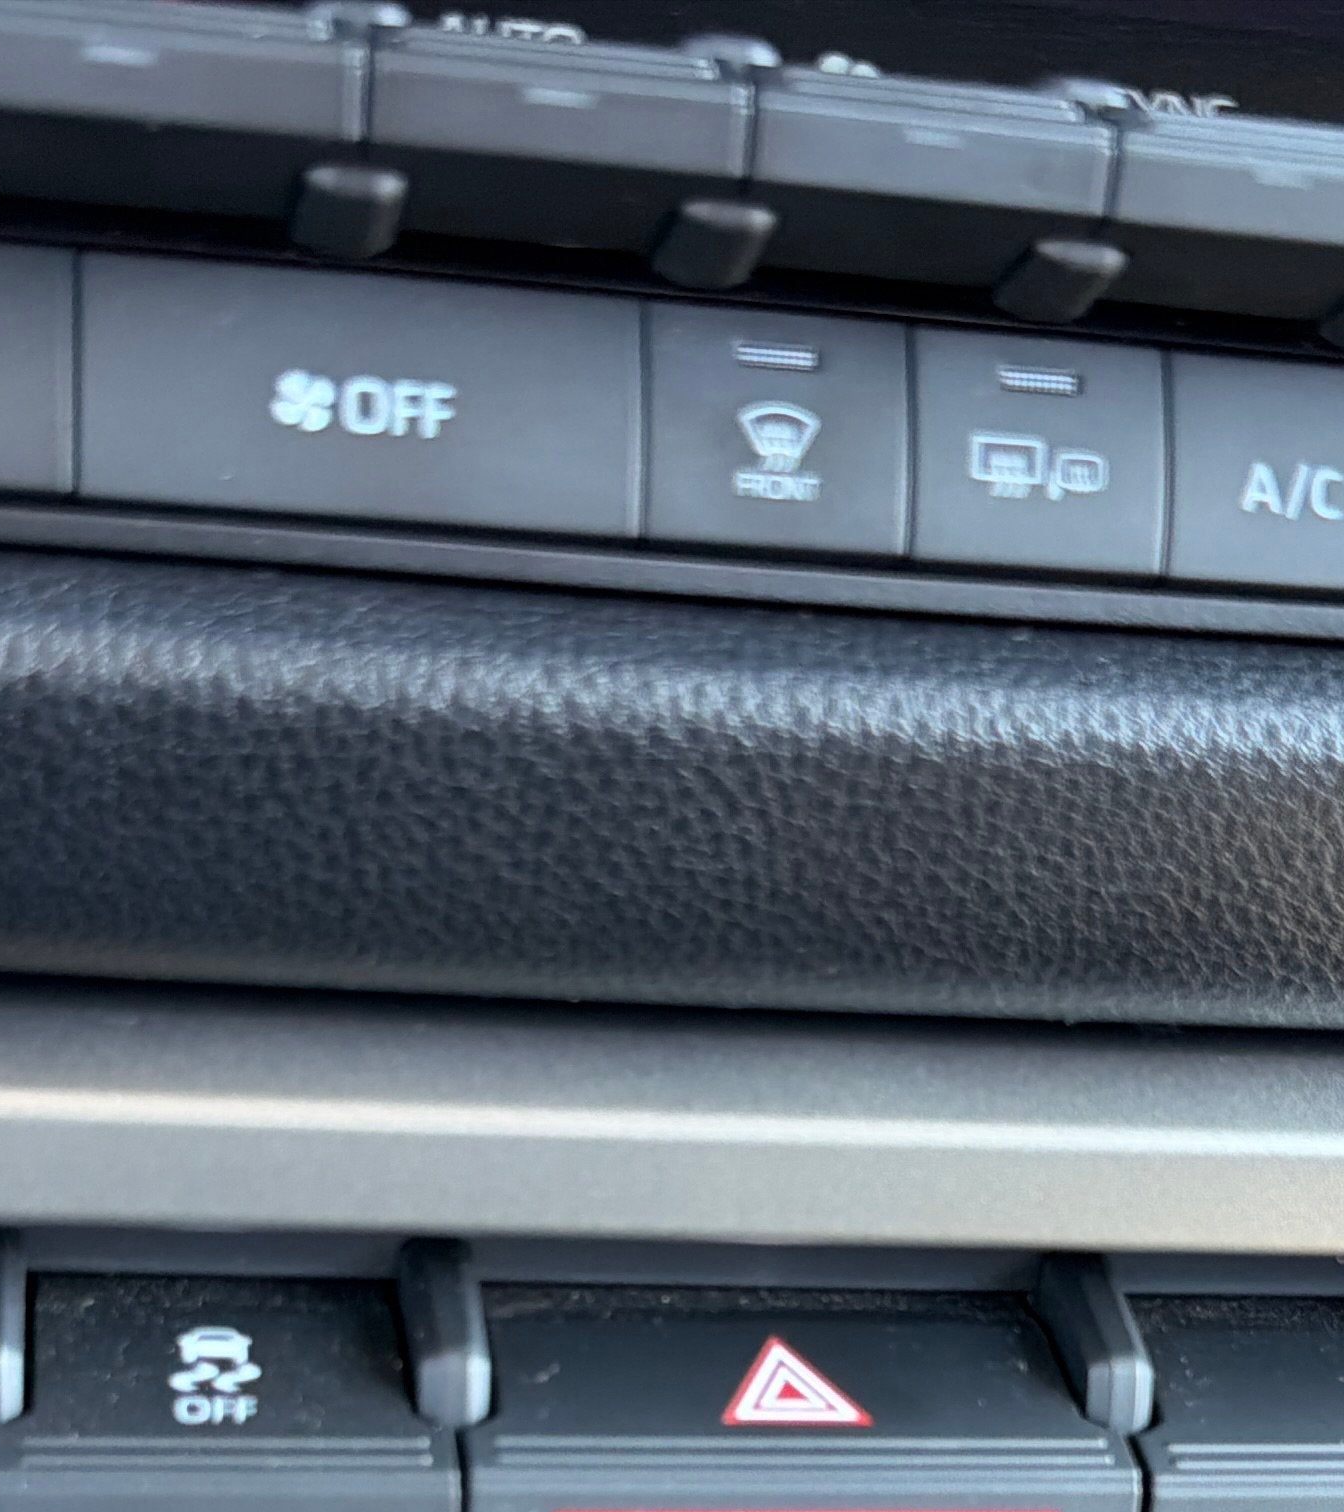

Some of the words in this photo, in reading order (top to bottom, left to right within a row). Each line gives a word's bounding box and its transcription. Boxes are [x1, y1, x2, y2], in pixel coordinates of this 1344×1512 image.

[338, 375, 457, 439] OFF
[733, 470, 821, 501] FRONT
[173, 1394, 258, 1425] OFF
